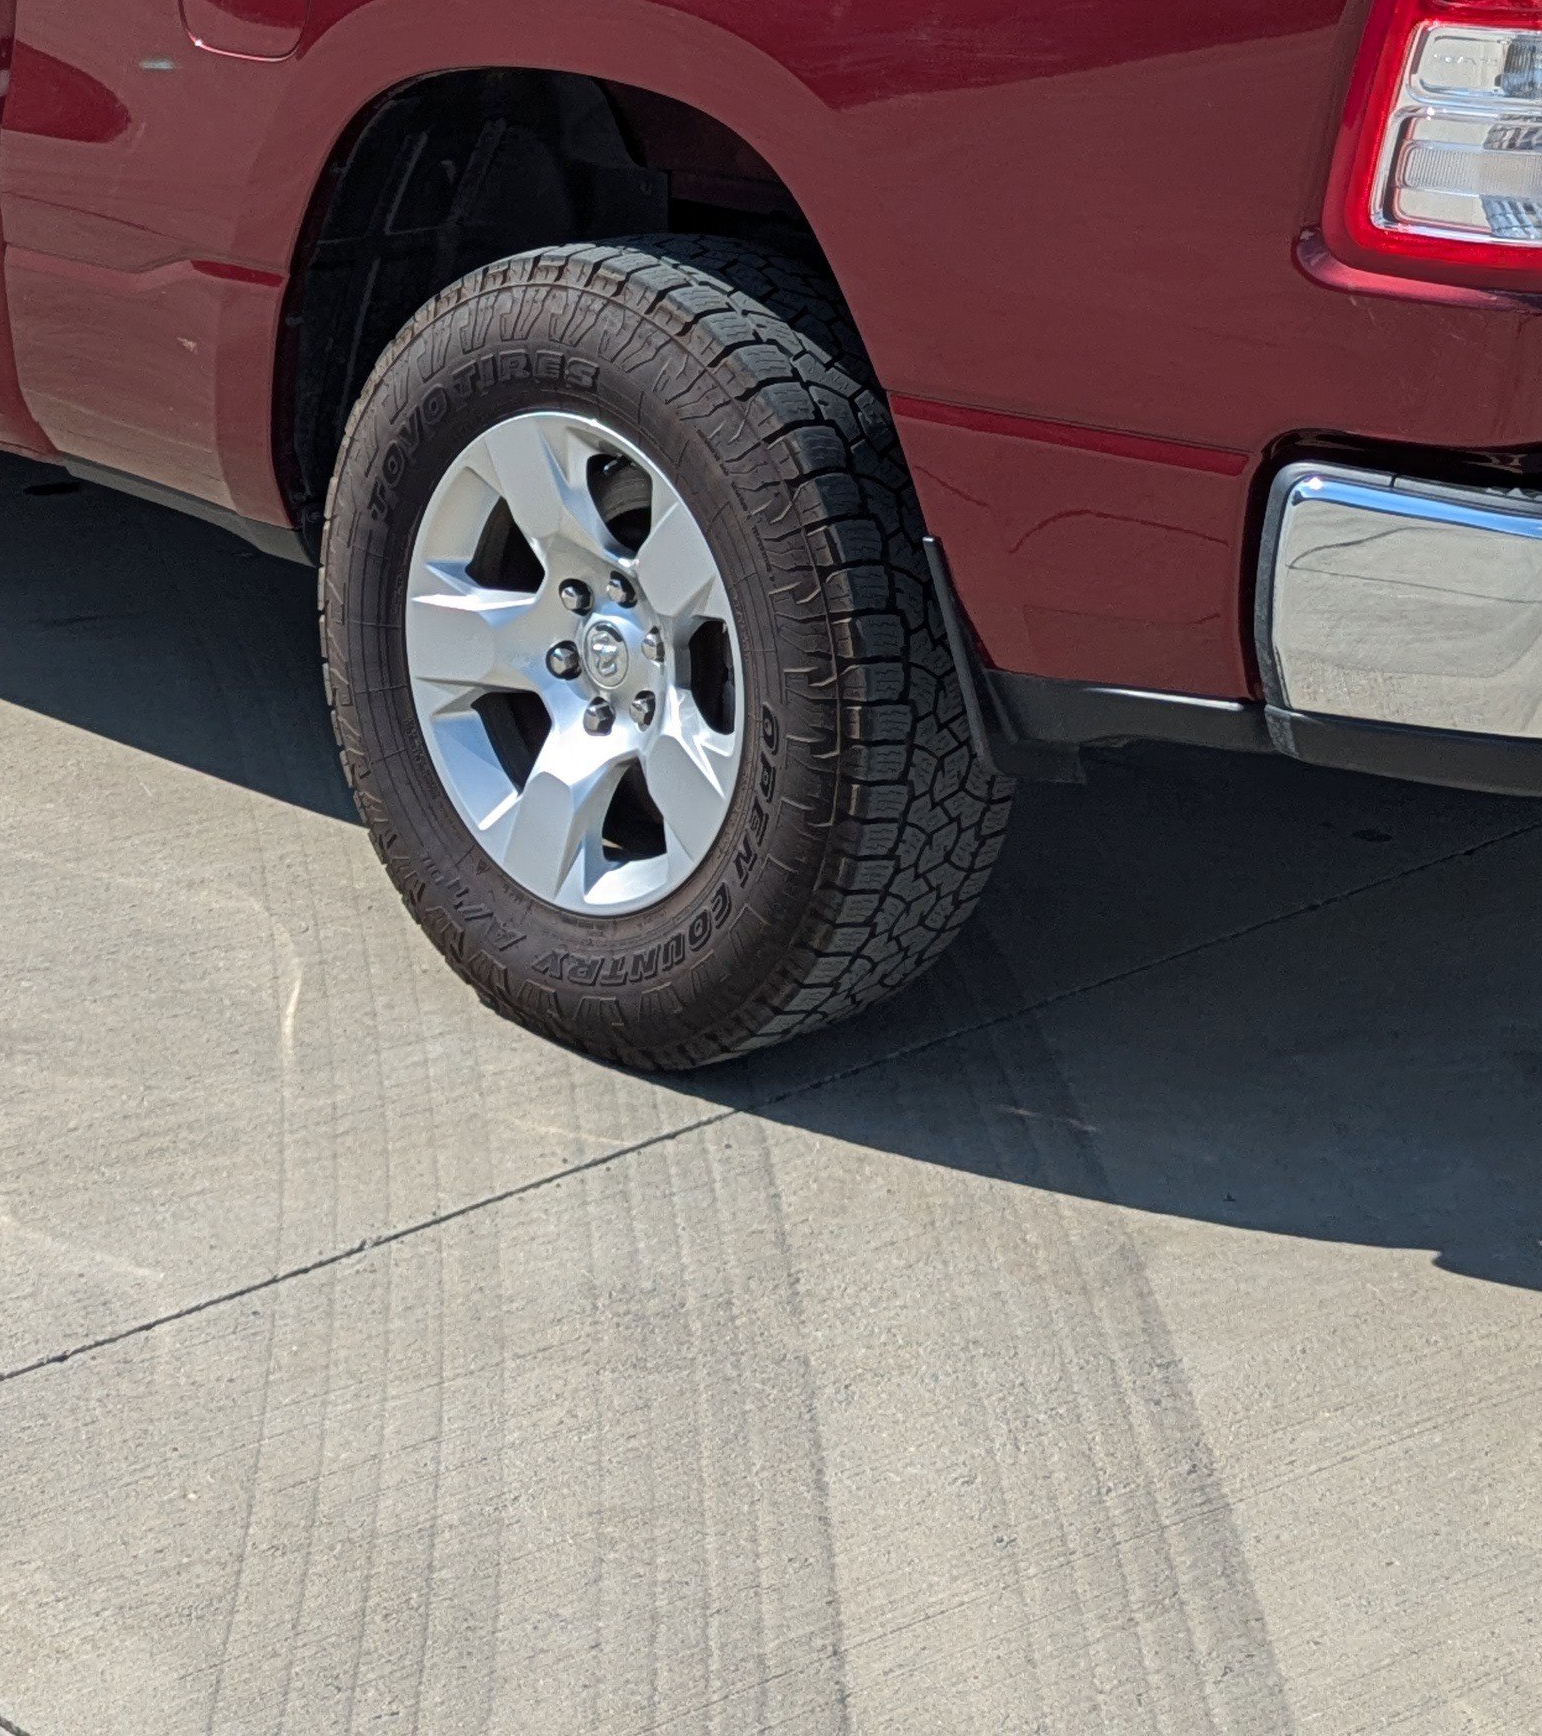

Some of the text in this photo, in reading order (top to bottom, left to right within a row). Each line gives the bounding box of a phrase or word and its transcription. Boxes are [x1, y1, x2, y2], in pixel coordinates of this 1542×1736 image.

[367, 349, 600, 521] TOYO TIRES
[733, 702, 780, 888] OPEN
[531, 881, 734, 986] COUNTRY
